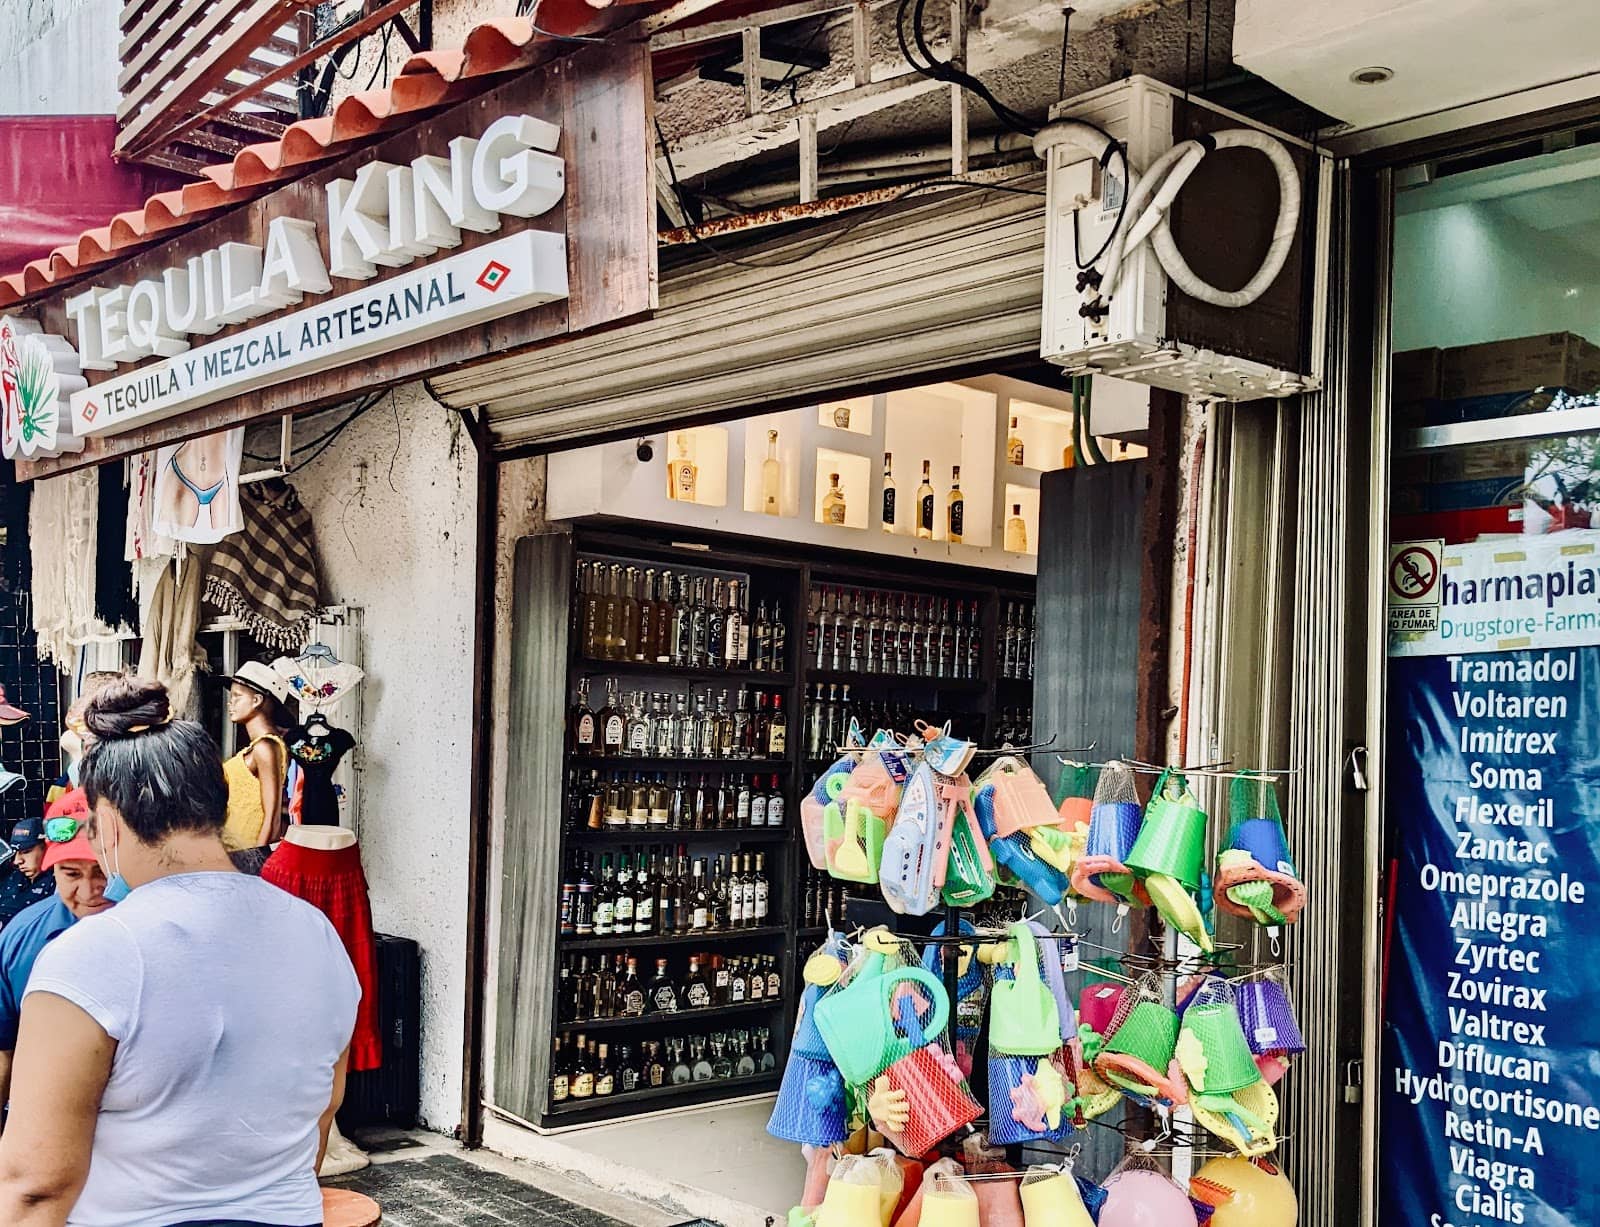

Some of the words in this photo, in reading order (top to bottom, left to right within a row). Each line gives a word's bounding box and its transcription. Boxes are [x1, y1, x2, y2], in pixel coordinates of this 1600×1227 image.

[66, 217, 318, 370] TEQUILA
[326, 114, 560, 279] KING
[103, 368, 180, 415] TEQUILA
[185, 360, 196, 386] Y
[203, 331, 291, 381] MEZCAL
[299, 272, 465, 351] ARTESANAL
[1391, 610, 1416, 618] AREA
[1419, 610, 1431, 618] DE
[1402, 619, 1435, 628] FUMAR
[1441, 612, 1600, 642] Drugstore-Farm
[1446, 652, 1576, 683] Tramadol
[1452, 691, 1567, 718] Voltaren
[1461, 726, 1556, 754] Imitrex
[1469, 761, 1542, 790] Soma
[1455, 796, 1553, 827] Flexeril
[1455, 832, 1548, 863] Zantac
[1420, 864, 1585, 904] Omeprazole
[1450, 902, 1547, 943] Allegra
[1454, 938, 1540, 973] Zyrtec
[1447, 971, 1547, 1011] Zovirax
[1448, 1006, 1546, 1046] Valtrex
[1438, 1041, 1549, 1084] Diflucan
[1395, 1068, 1600, 1129] Hydrocortisone
[1445, 1111, 1544, 1155] Retin-A
[1449, 1147, 1535, 1190] Viagra
[1455, 1184, 1525, 1225] Cialis
